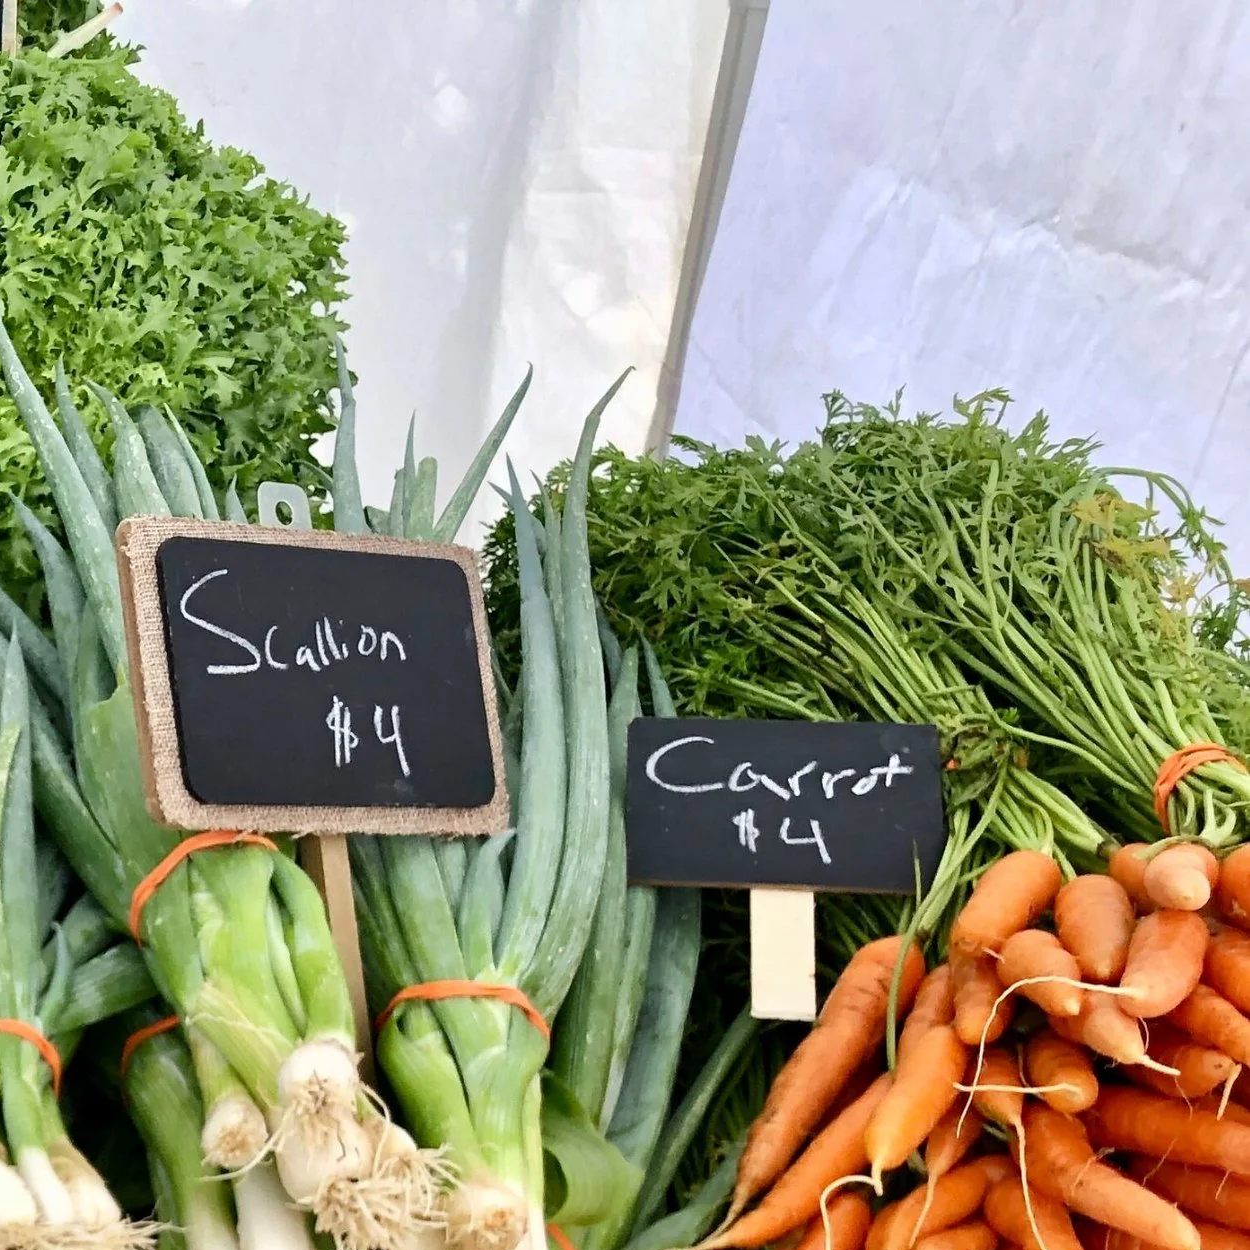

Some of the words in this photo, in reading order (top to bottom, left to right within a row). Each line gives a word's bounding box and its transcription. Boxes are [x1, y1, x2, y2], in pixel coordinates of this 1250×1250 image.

[180, 568, 407, 675] Scallion
[325, 695, 411, 778] $4
[646, 735, 914, 801] Carrot
[731, 807, 832, 864] $4
